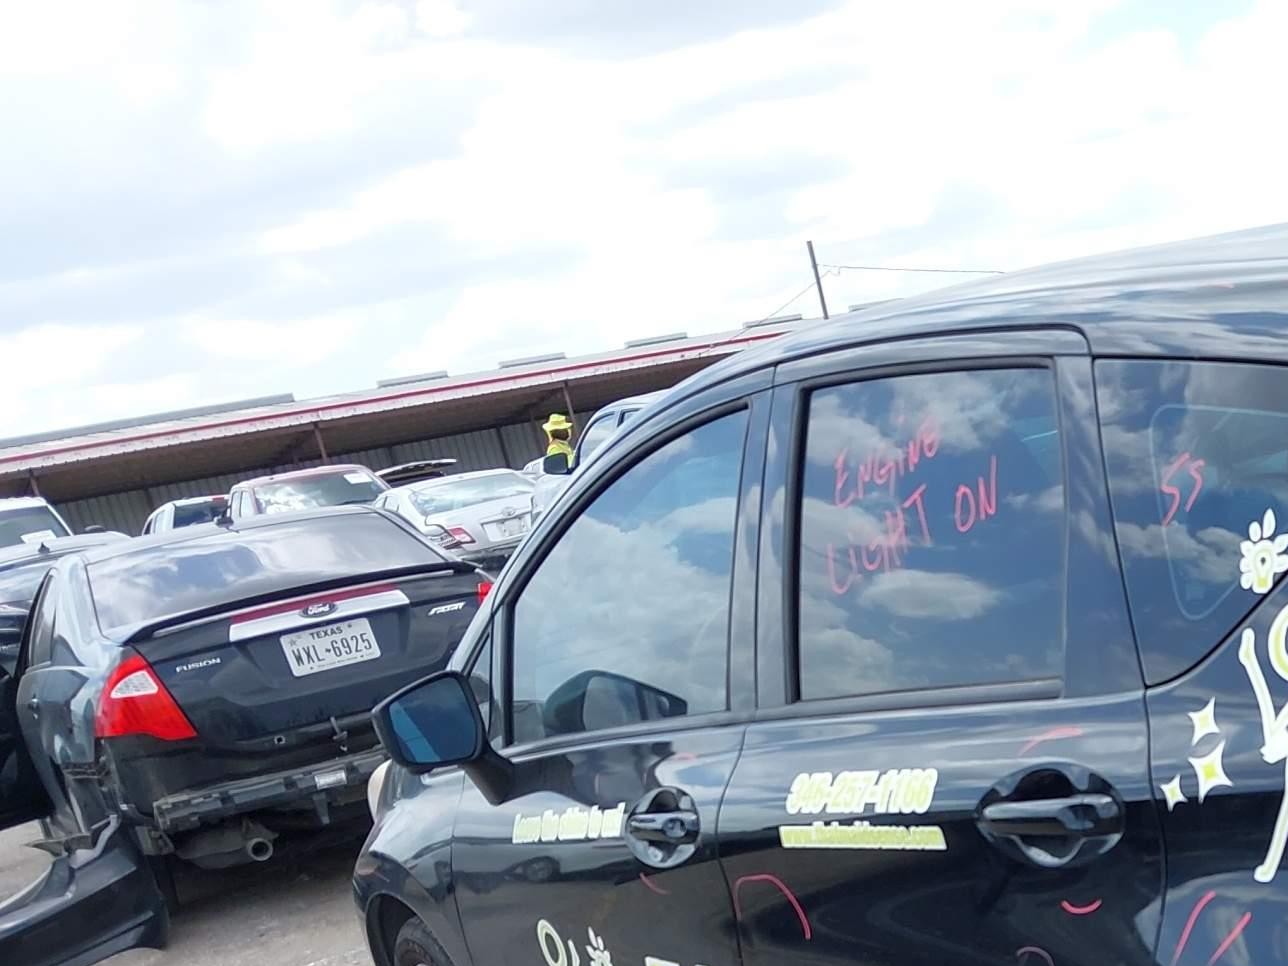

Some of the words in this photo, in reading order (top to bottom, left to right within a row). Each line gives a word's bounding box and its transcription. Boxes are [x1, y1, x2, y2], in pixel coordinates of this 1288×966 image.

[955, 455, 997, 533] ON
[309, 626, 343, 641] TEXAS
[175, 657, 222, 673] FUSION
